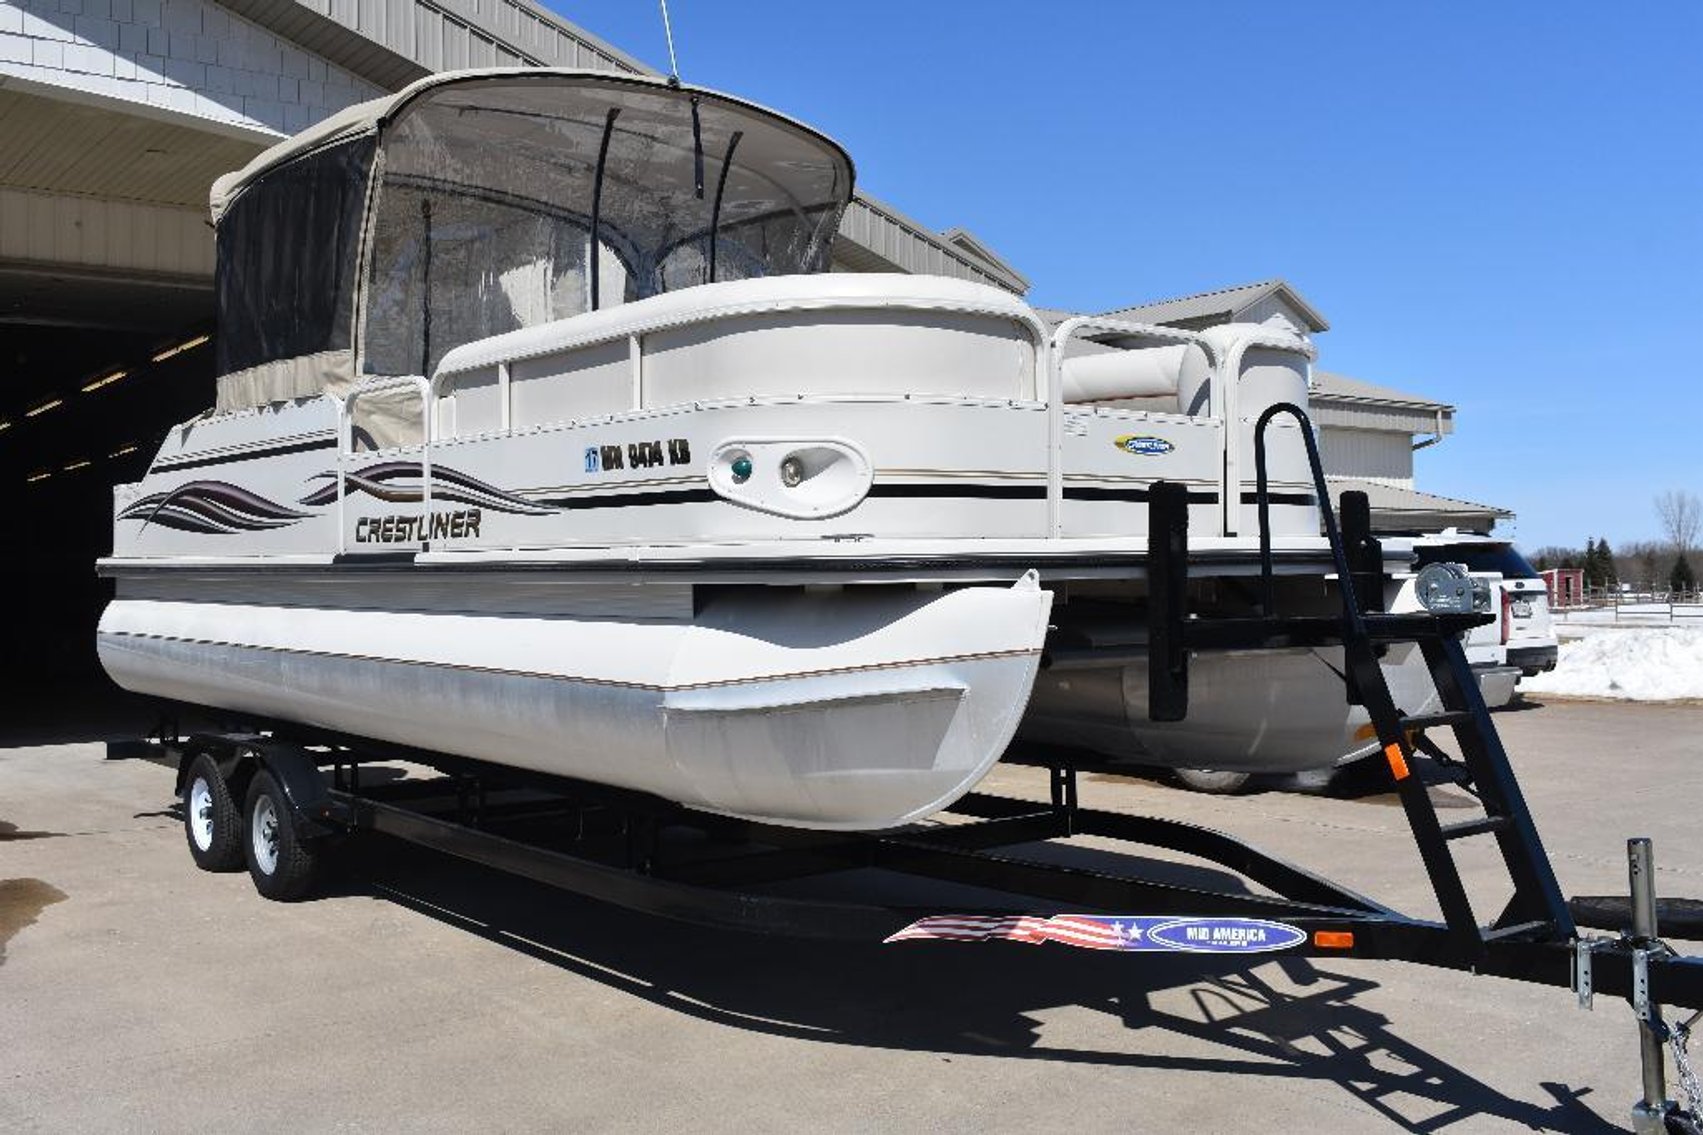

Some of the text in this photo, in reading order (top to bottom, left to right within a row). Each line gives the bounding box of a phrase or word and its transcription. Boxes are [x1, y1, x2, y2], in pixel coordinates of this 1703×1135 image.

[355, 508, 482, 543] CRESTLINER
[1186, 927, 1267, 943] MID AMERICA
